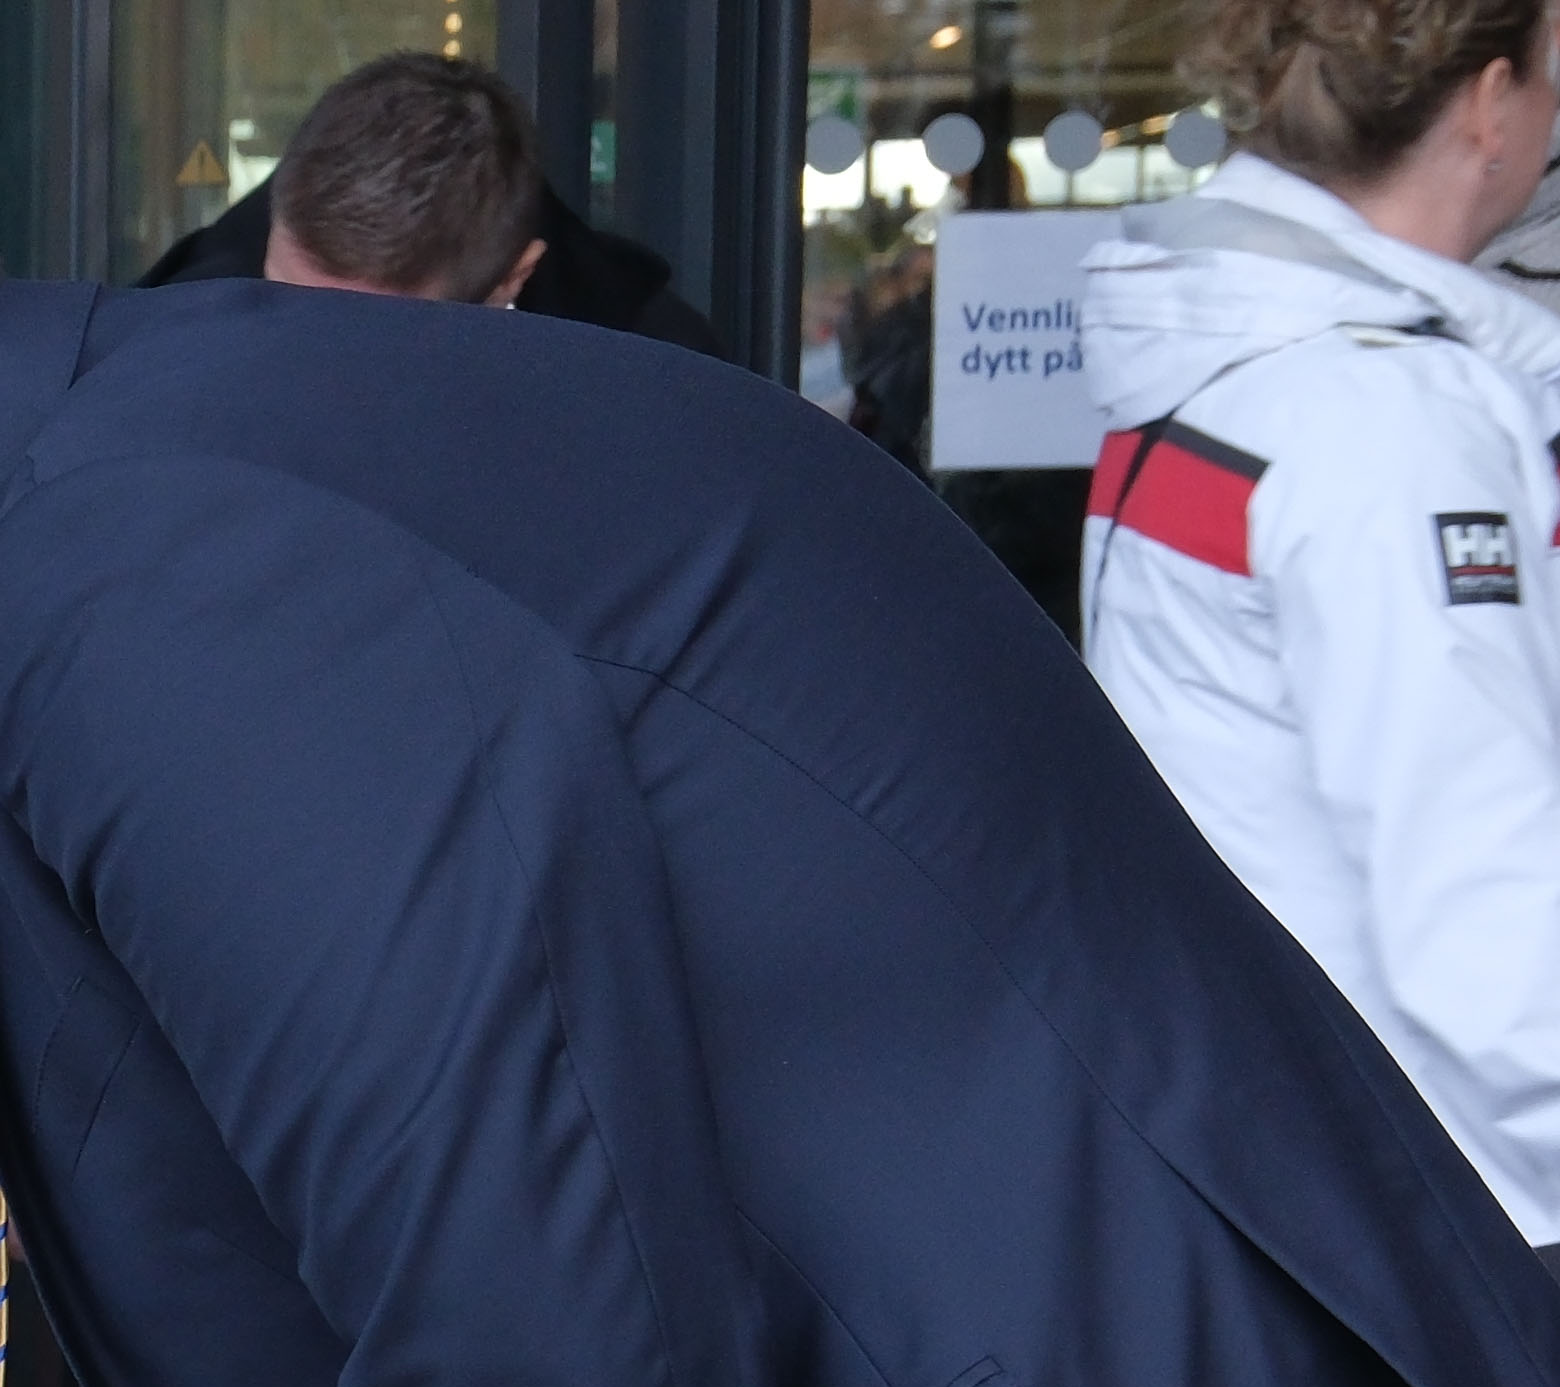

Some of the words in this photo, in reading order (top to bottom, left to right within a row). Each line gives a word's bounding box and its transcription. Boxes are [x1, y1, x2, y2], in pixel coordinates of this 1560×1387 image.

[963, 299, 1084, 334] Vennli
[961, 344, 1032, 381] dytt
[1043, 342, 1083, 381] på
[1441, 523, 1515, 568] HH
